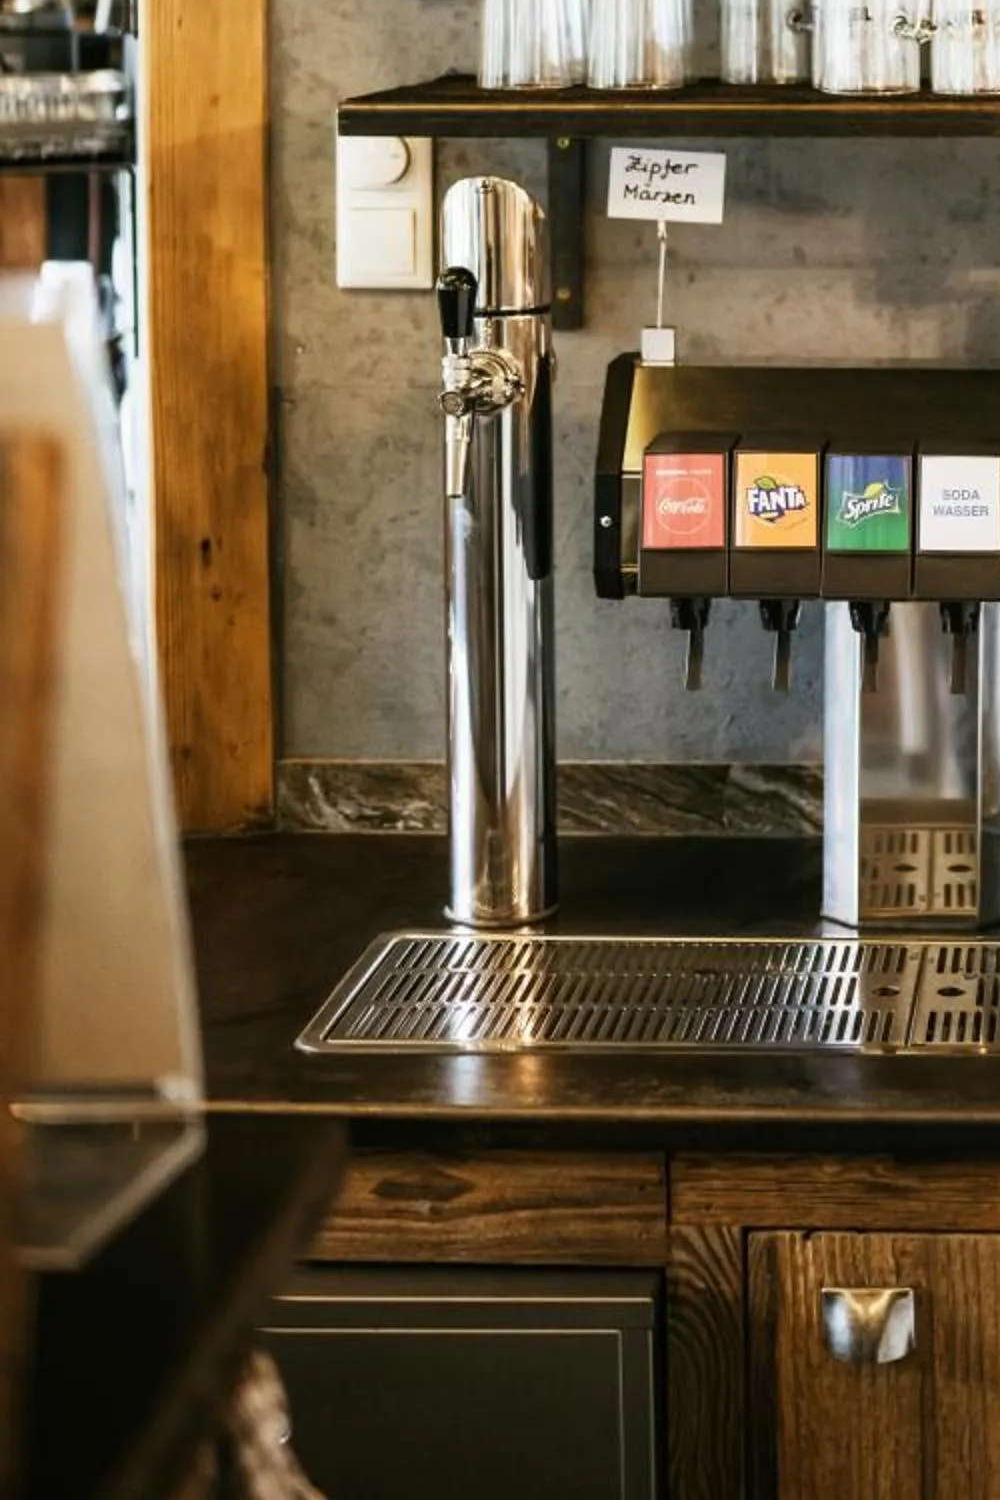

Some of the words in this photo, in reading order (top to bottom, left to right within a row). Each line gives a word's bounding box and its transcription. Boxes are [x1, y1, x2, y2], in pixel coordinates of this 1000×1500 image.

[625, 155, 699, 181] Zipfer
[623, 182, 695, 205] Märzen
[942, 489, 980, 501] SODA
[844, 494, 895, 520] Sprite
[932, 504, 989, 517] WASSER
